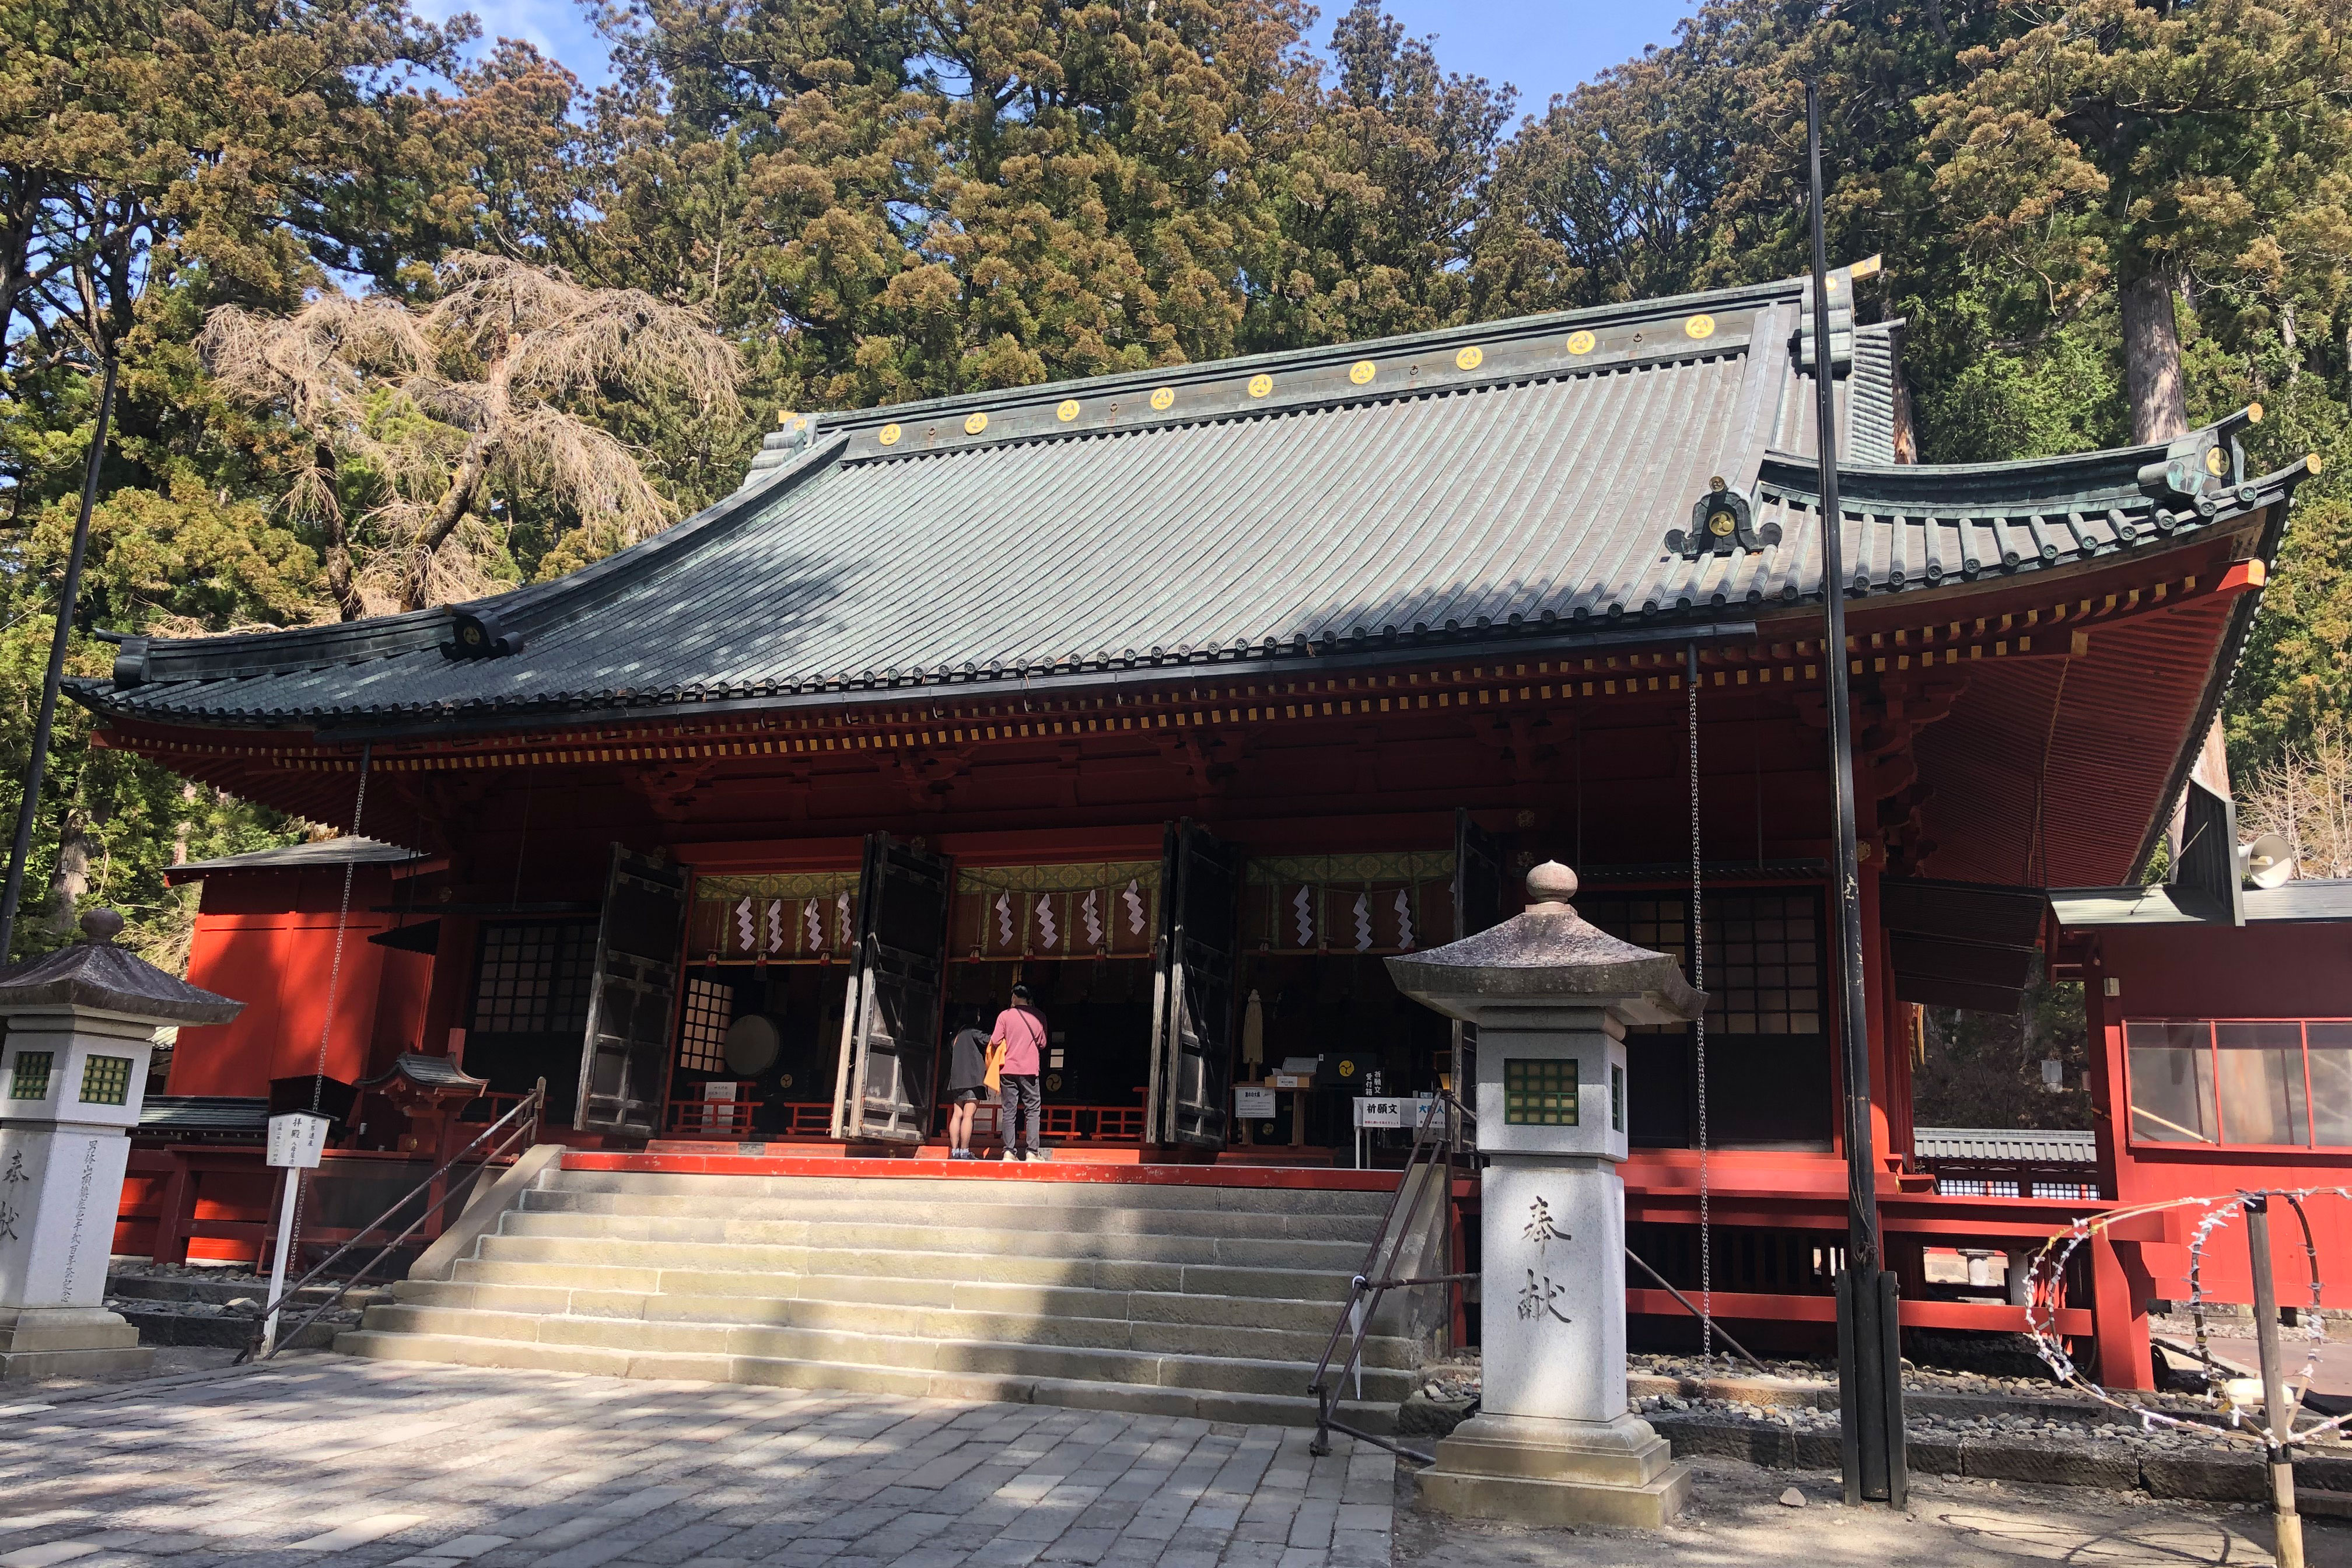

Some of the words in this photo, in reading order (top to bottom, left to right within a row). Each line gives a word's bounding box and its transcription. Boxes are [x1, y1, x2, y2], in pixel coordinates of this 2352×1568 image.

[1367, 1103, 1398, 1114] 祈願文
[307, 1118, 316, 1146] 世界遺産
[1517, 1195, 1572, 1323] 奉献
